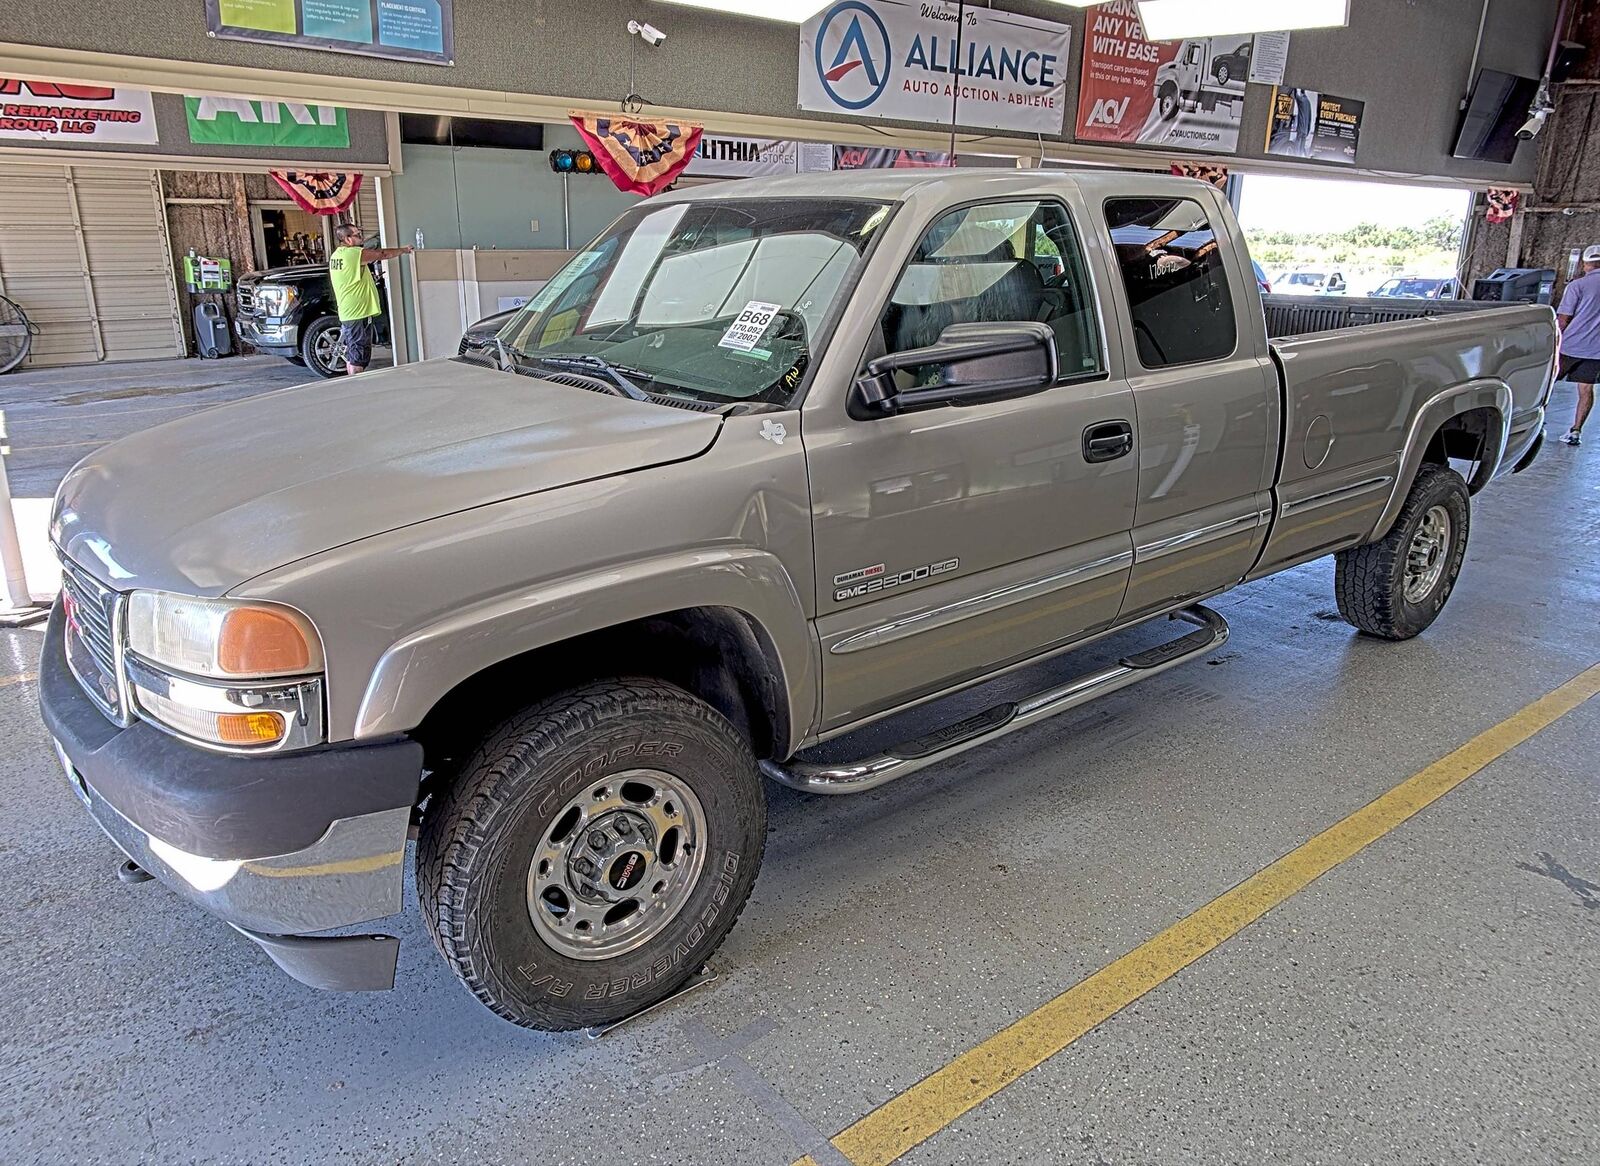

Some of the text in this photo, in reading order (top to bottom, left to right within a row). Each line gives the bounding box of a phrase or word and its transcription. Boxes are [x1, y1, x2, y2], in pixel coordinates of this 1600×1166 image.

[965, 11, 977, 26] To
[1092, 15, 1144, 40] ANY VE
[1093, 35, 1160, 63] WITH EASE.
[904, 33, 1057, 88] ALLIANCE
[1091, 59, 1113, 71] Transport
[1124, 66, 1150, 76] purchased
[1095, 71, 1105, 80] this
[1111, 75, 1120, 84] any
[1120, 75, 1132, 84] lane.
[1132, 76, 1148, 87] Today.
[903, 79, 939, 95] AUTO
[944, 84, 999, 102] AUCTION
[1007, 92, 1055, 109] ABILENE
[3, 103, 142, 123] REMARKETING
[1085, 96, 1131, 127] ACV
[1320, 101, 1341, 112] PROTECT
[61, 121, 97, 134] LLC
[702, 139, 785, 162] LITHIA AUTO
[762, 153, 795, 165] STORES
[739, 310, 771, 326] B68
[732, 323, 763, 335] 170,092
[737, 332, 758, 342] 2002
[836, 565, 884, 583] DURAMAX DIESEL
[836, 585, 867, 600] GMC
[538, 741, 685, 818] COOPER
[616, 853, 639, 889] GMC
[585, 850, 740, 1000] DISCOVERER
[517, 962, 574, 998] A/T
